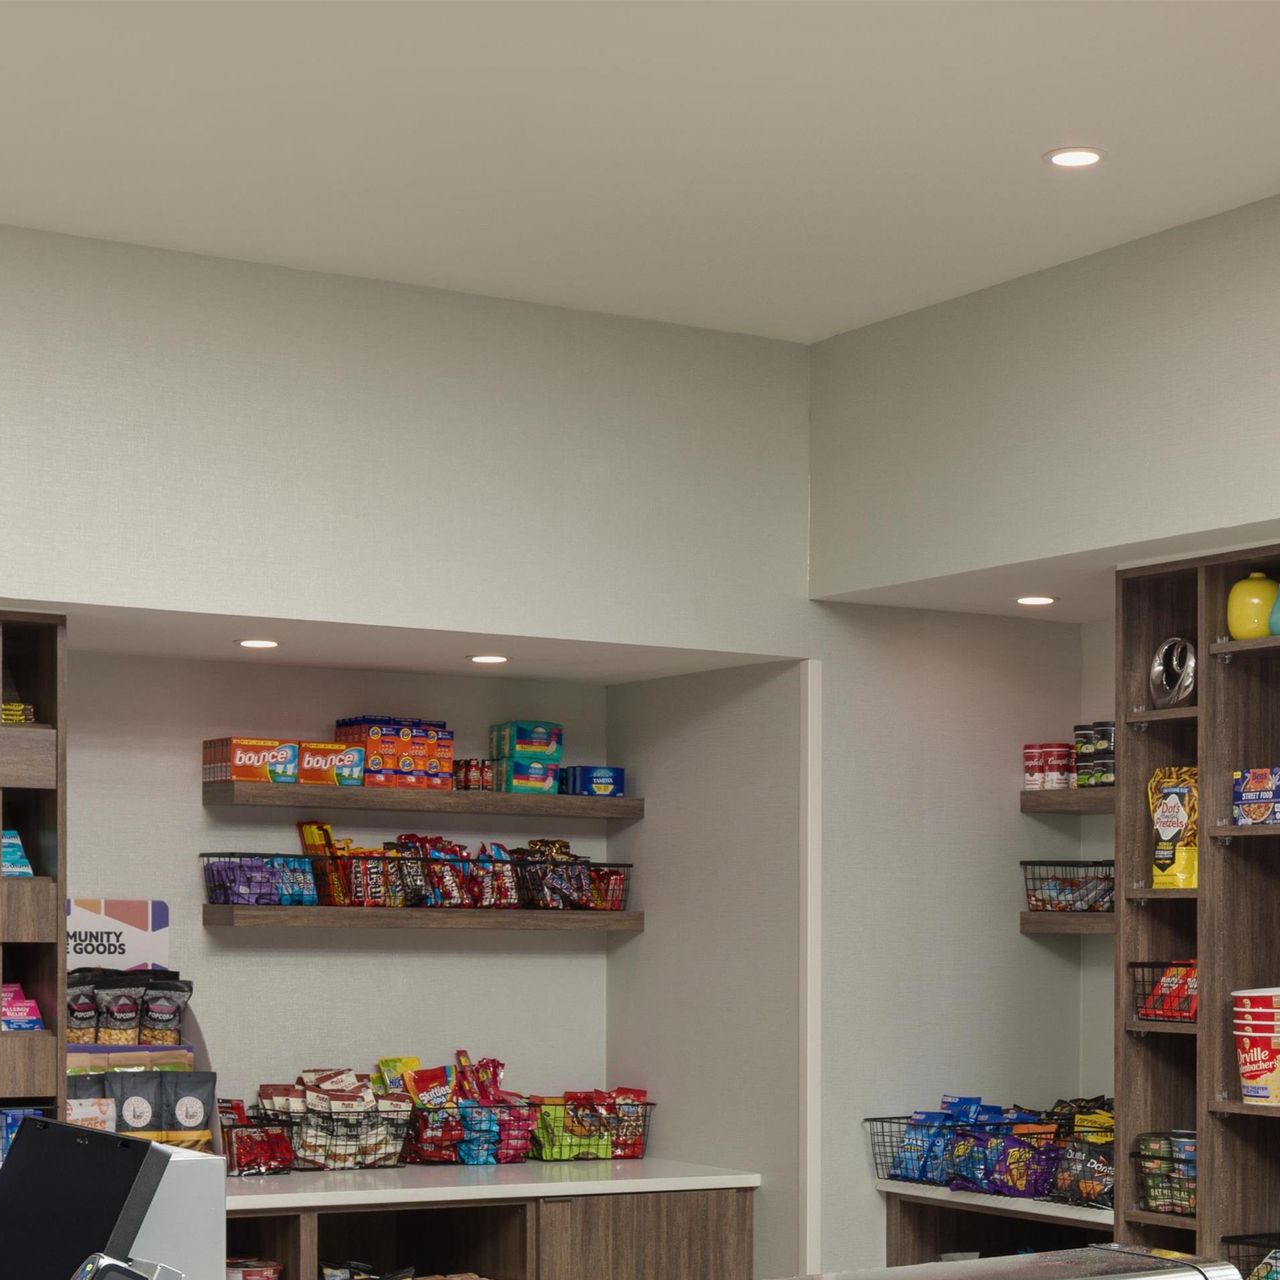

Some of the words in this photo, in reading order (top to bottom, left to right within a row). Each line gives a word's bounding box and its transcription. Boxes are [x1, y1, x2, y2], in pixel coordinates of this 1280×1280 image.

[234, 748, 288, 766] bounce
[302, 752, 356, 769] bounce
[1242, 791, 1260, 800] STREET
[1260, 790, 1273, 799] FOOD
[1161, 802, 1180, 814] Dot's
[1155, 817, 1185, 829] Pretzels
[73, 943, 126, 955] GOODS
[74, 1010, 95, 1018] POPCORN
[114, 1011, 136, 1020] POPCORN
[149, 1011, 174, 1020] POPCORN
[419, 1084, 452, 1103] Skittles
